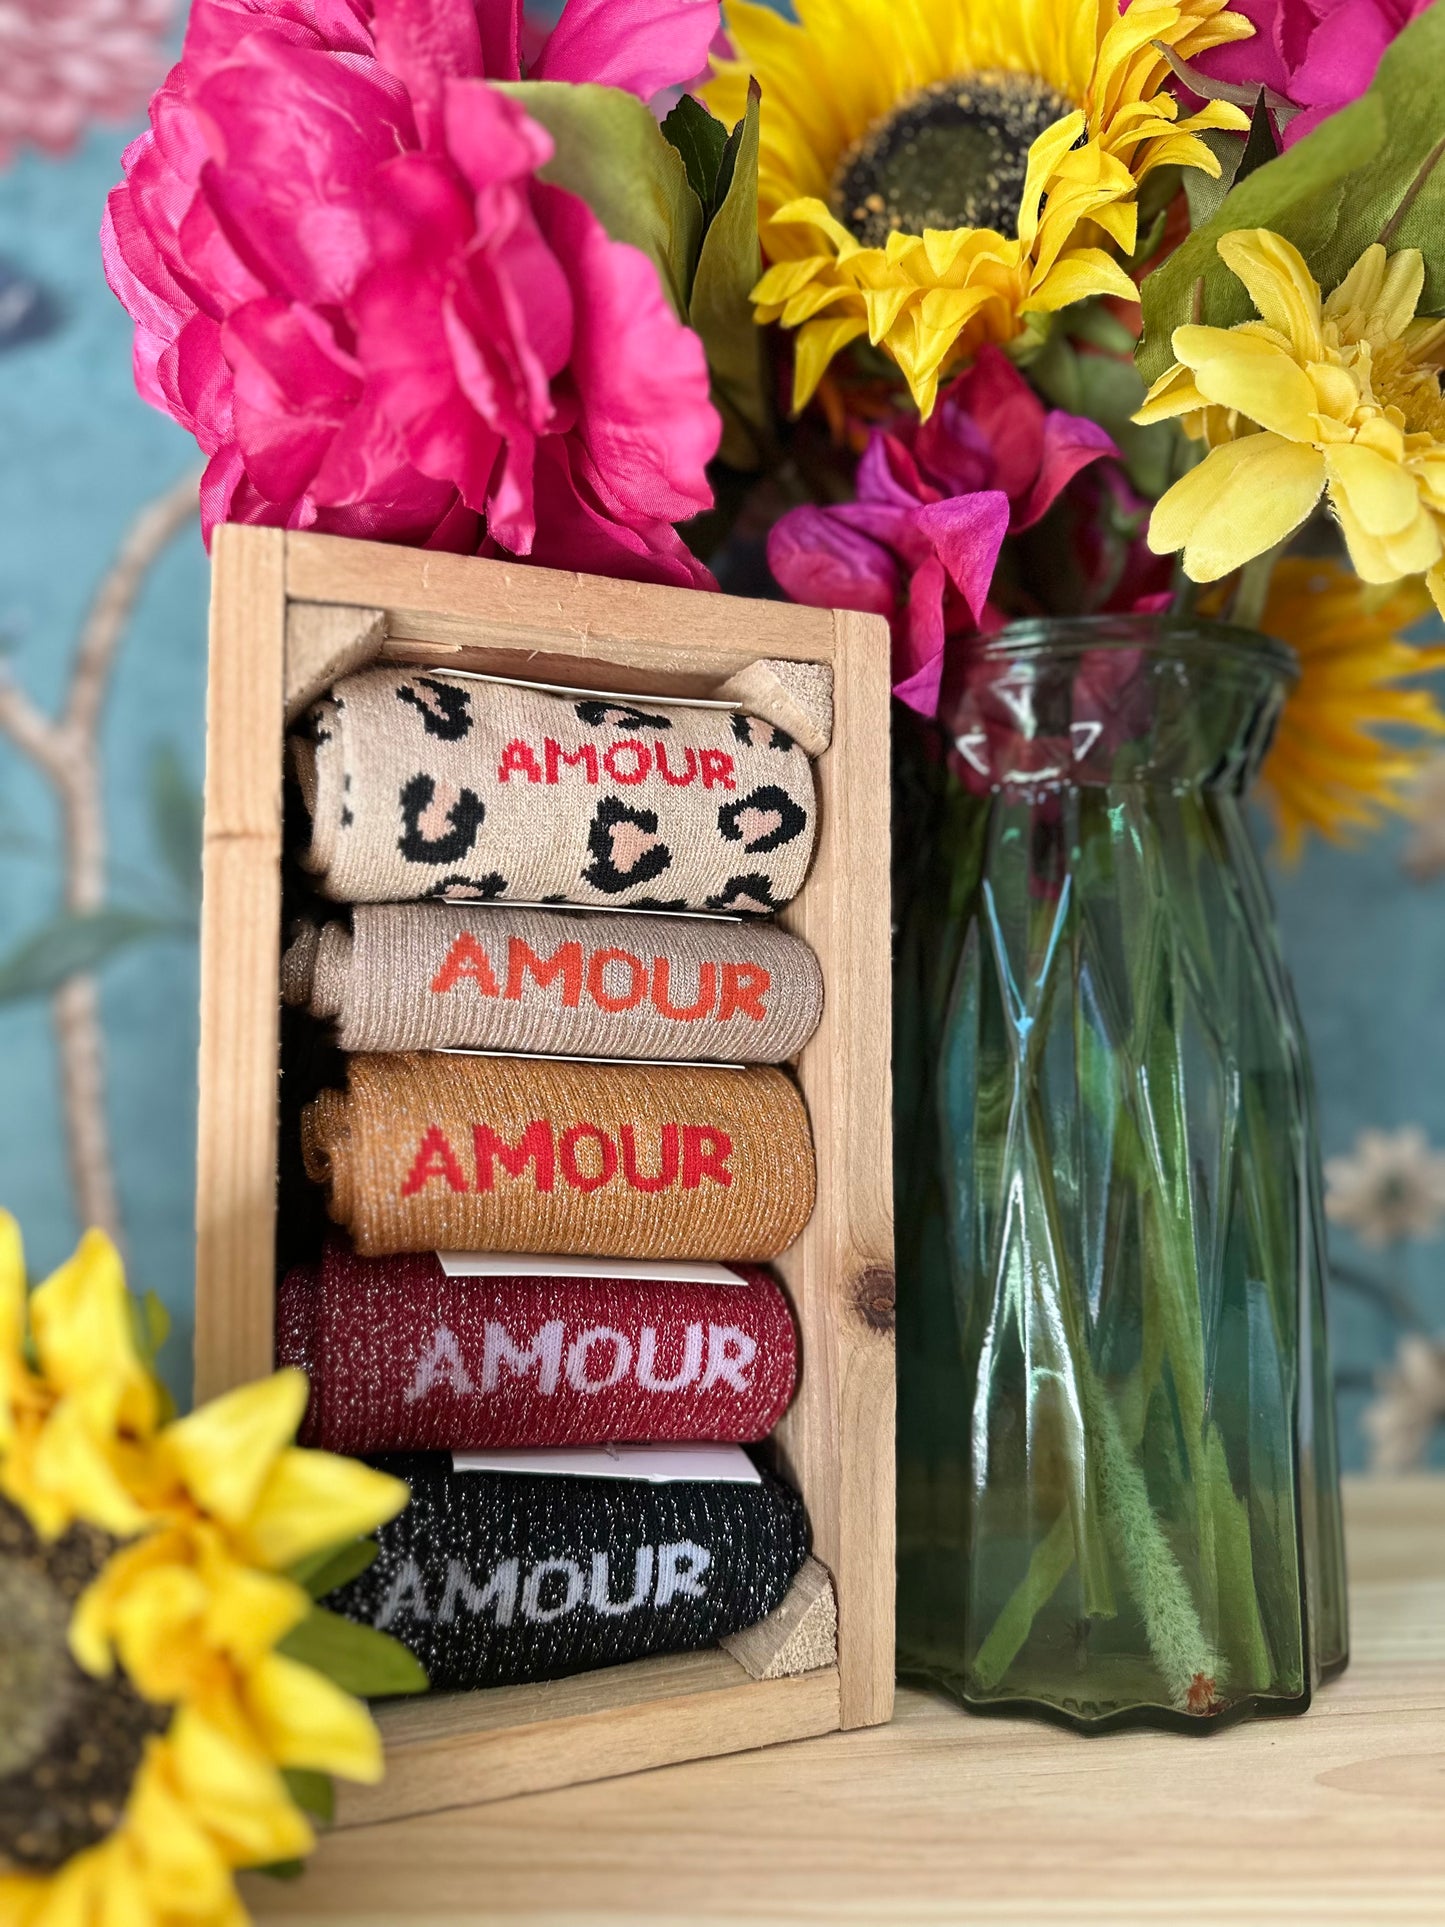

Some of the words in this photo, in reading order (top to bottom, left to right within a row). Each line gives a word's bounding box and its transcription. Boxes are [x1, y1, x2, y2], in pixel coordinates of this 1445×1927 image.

[499, 739, 736, 790] AMOUR
[432, 932, 771, 1021] AMOUR
[402, 1121, 734, 1196] AMOUR
[405, 1319, 757, 1401] AMOUR
[376, 1540, 711, 1628] AMOUR
